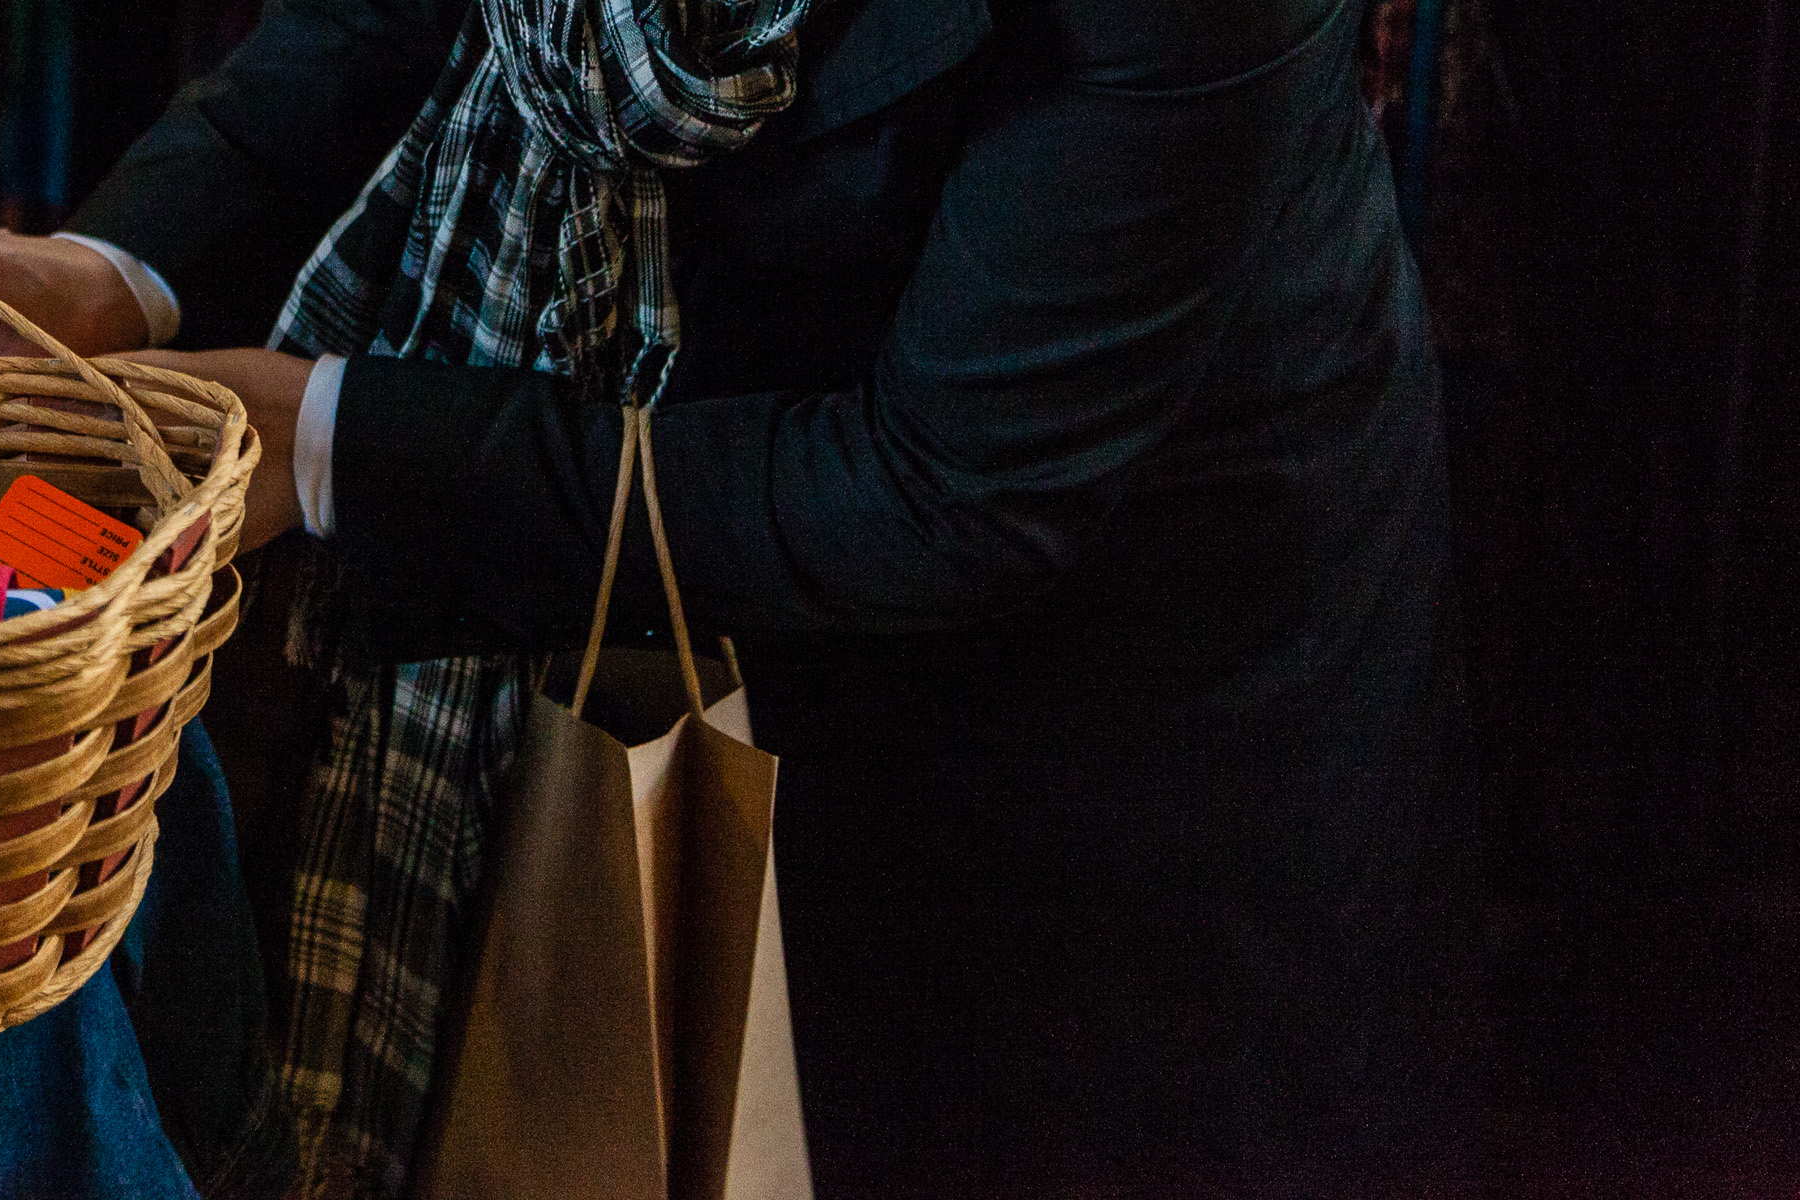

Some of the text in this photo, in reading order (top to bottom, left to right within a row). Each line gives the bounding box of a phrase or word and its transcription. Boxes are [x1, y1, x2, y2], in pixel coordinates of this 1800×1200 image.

[99, 528, 130, 548] PRICE
[97, 546, 120, 562] SIZE
[81, 556, 111, 576] STYLE
